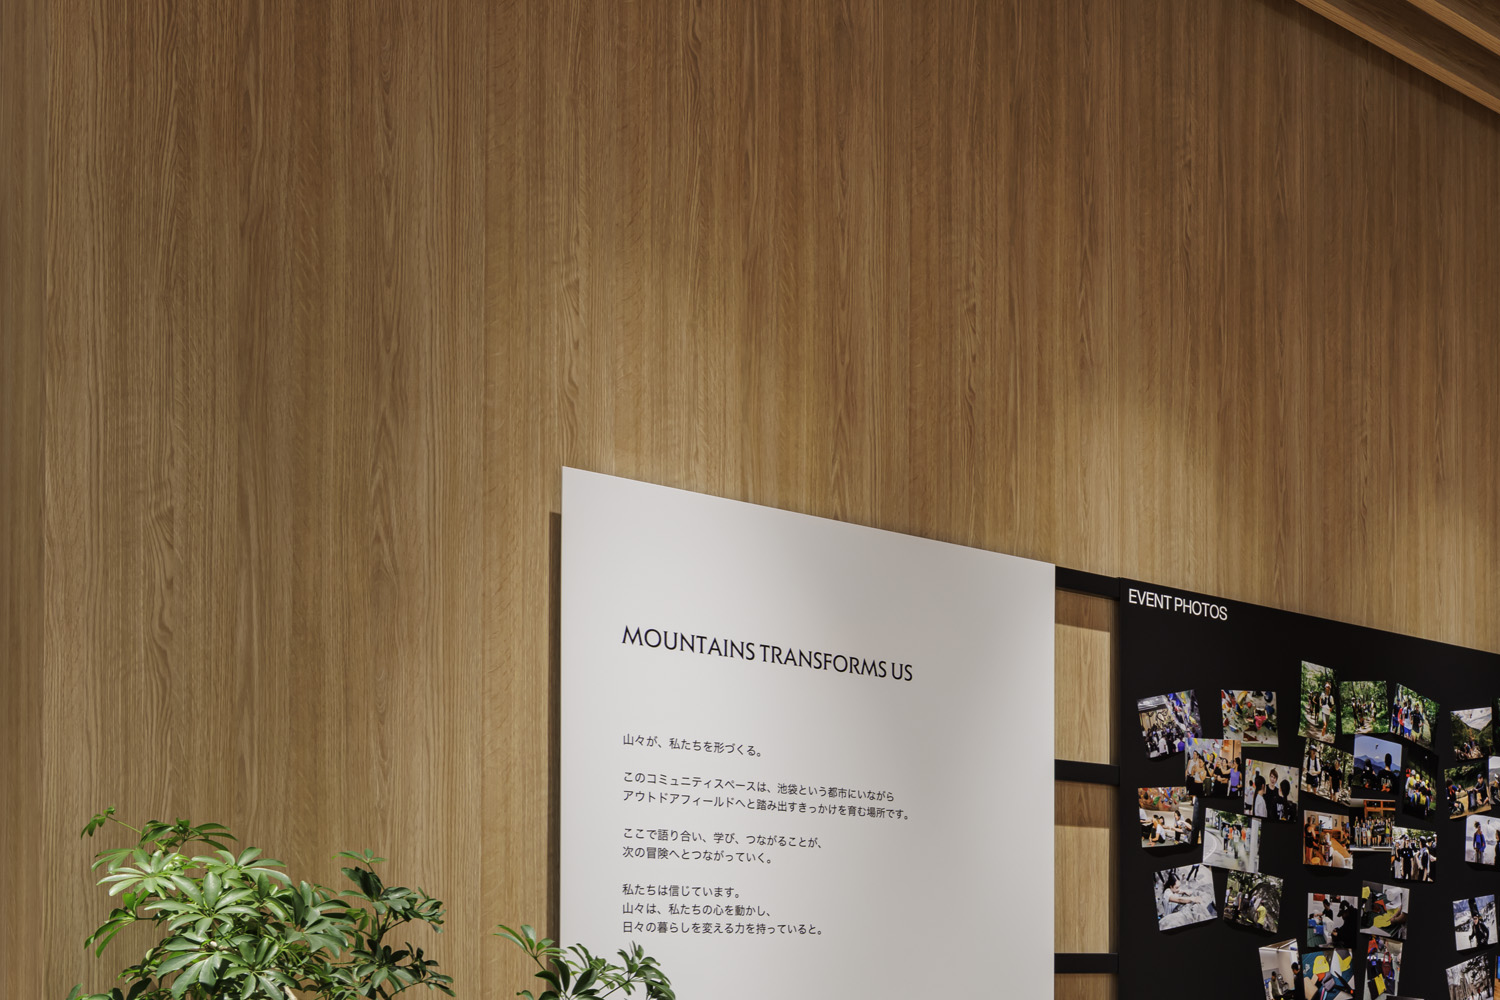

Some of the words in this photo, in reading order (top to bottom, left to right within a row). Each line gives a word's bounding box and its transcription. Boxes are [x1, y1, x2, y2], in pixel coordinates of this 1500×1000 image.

[1128, 588, 1172, 610] EVENT
[1174, 597, 1228, 621] PHOTOS
[622, 625, 755, 661] MOUNTAINS
[759, 644, 887, 678] TRANSFORMS
[891, 661, 913, 682] US
[623, 733, 762, 758] 山々が、私たちを形づくる。
[623, 771, 895, 802] このコミュニティスペースは、池袋という都市にいながら
[623, 790, 908, 820] アウトドアフィールドへと踏み出すきっかけを育む場所です。
[623, 828, 822, 848] ここで語り合い、学び、つながることが、
[622, 845, 771, 864] 次の冒険へとつながっていく。
[622, 883, 740, 899] 私たちは信じています。
[622, 902, 771, 917] 山々は、私たちの心を動かし、
[623, 921, 822, 936] 日々の暮らしを変える力を持っていると。
